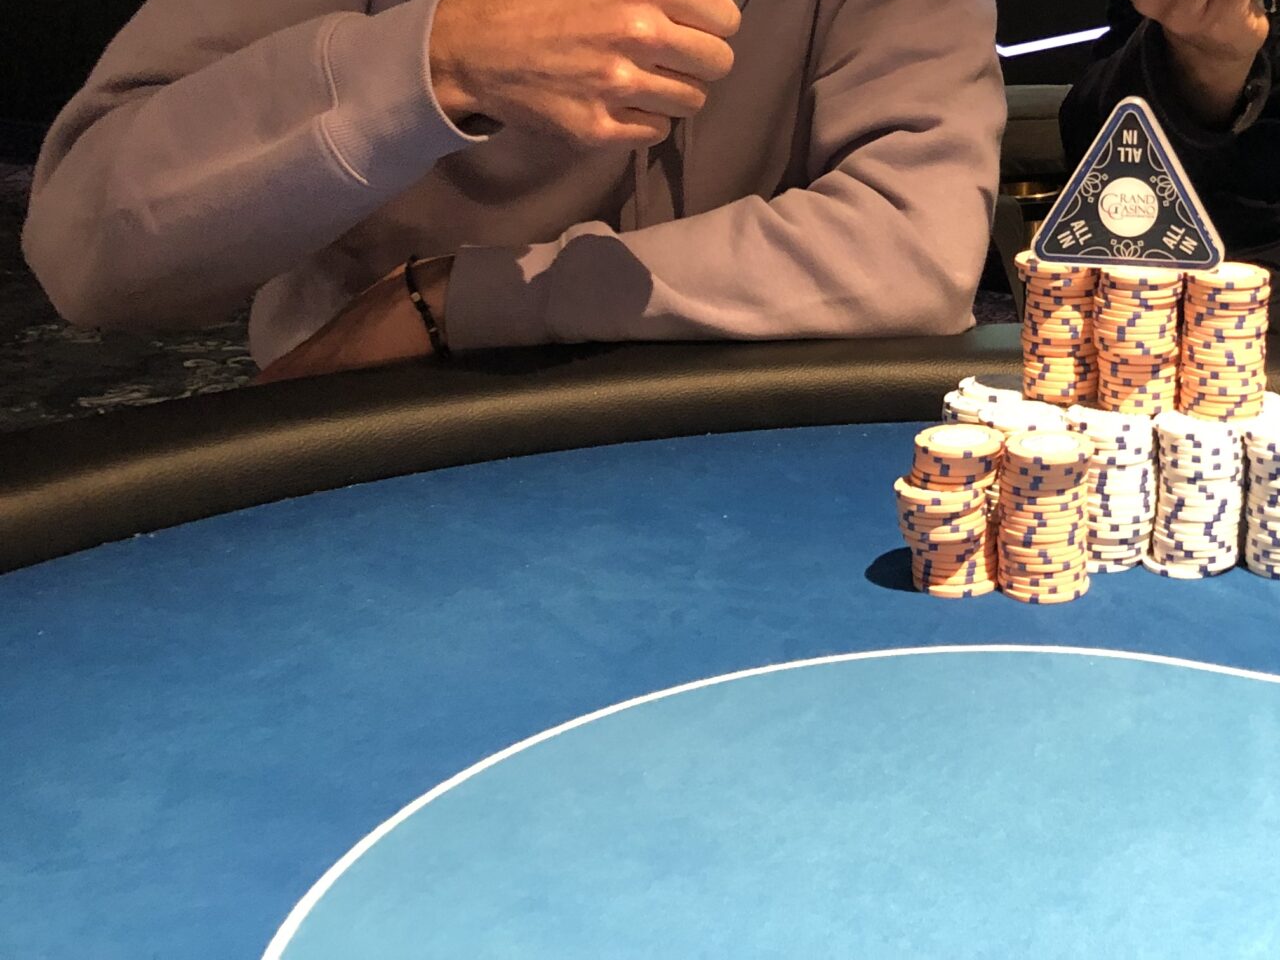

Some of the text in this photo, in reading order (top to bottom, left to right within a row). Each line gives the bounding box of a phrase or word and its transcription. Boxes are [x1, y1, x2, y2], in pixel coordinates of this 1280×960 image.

[1122, 129, 1138, 145] IN
[1117, 147, 1143, 164] ALL
[1056, 230, 1076, 249] IN
[1070, 220, 1093, 246] ALL
[1161, 224, 1186, 250] ALL
[1179, 236, 1198, 255] IN
